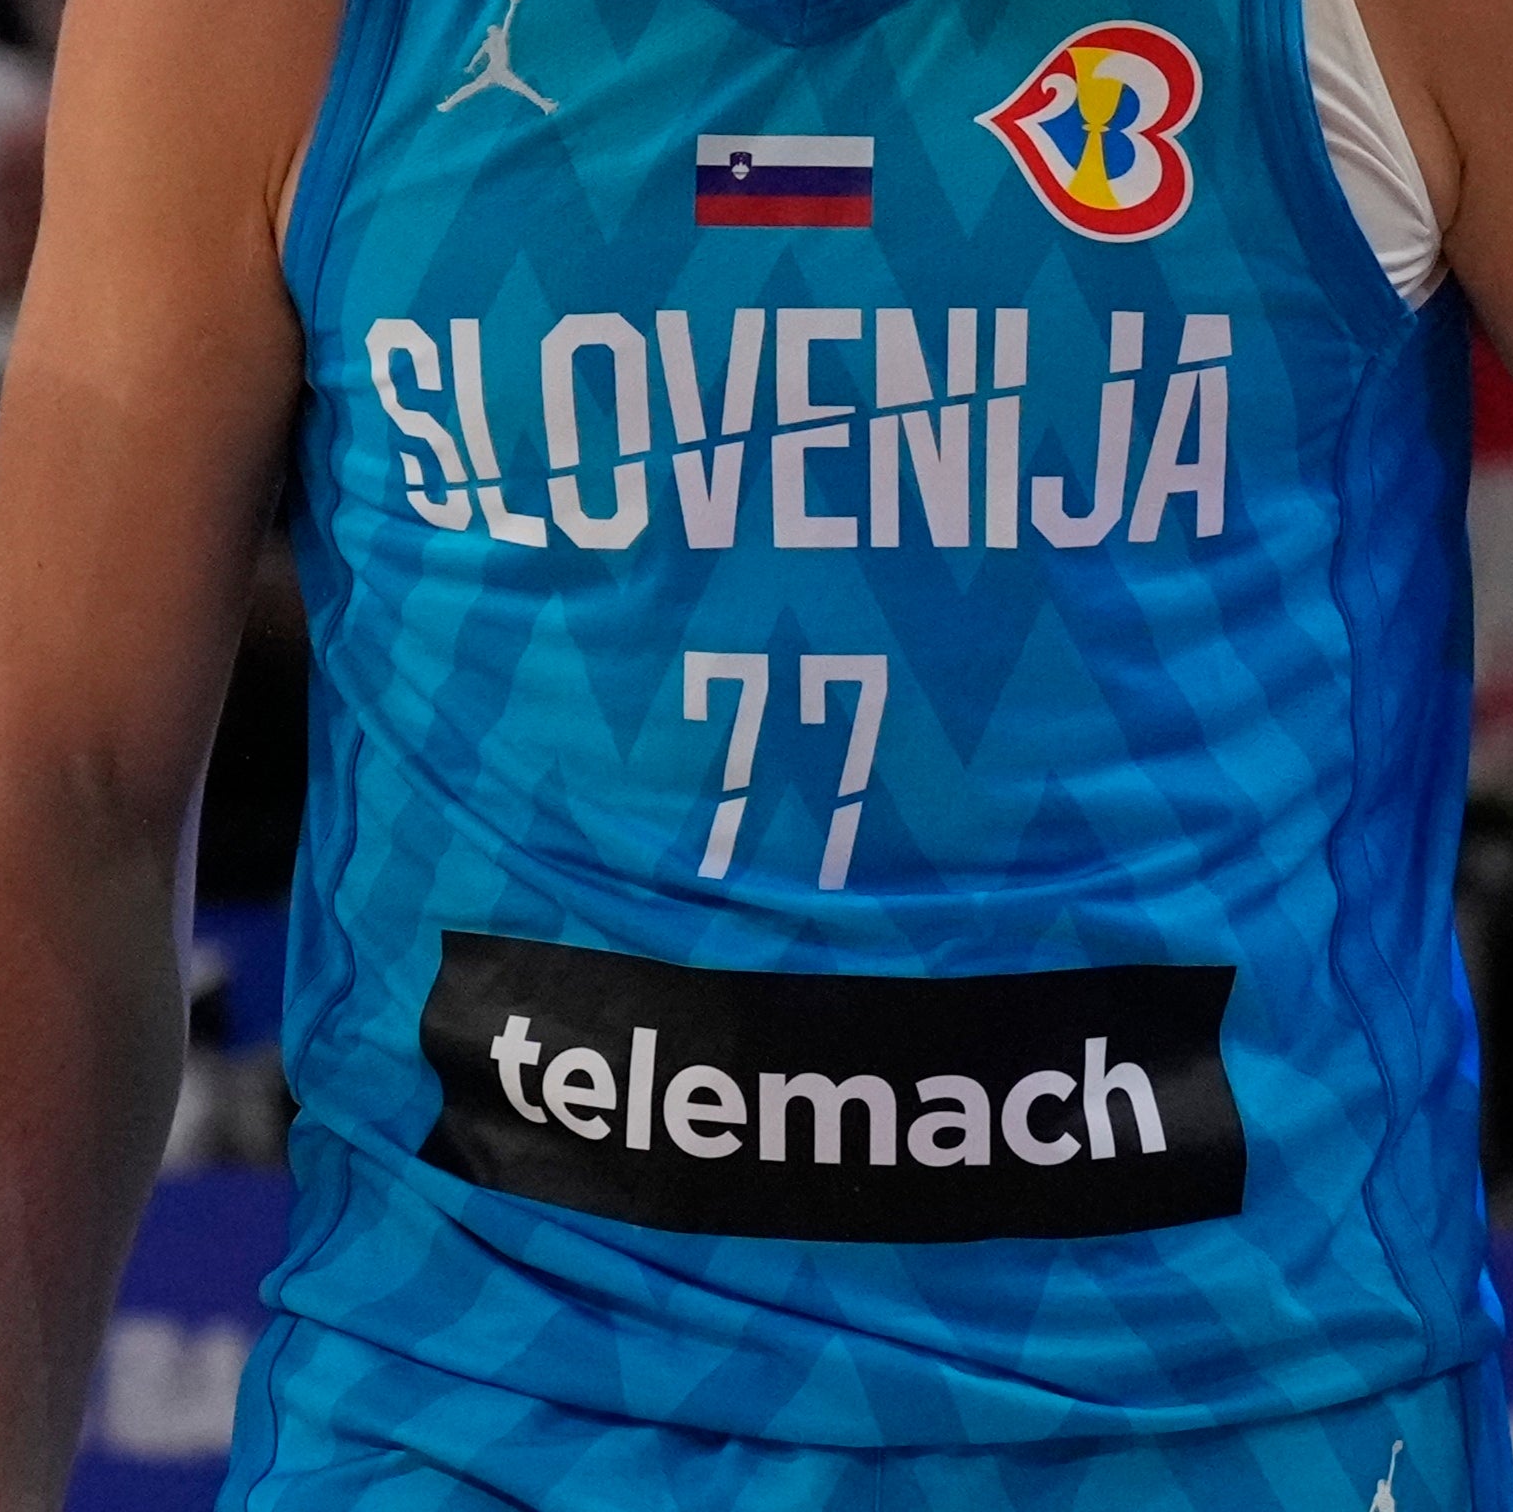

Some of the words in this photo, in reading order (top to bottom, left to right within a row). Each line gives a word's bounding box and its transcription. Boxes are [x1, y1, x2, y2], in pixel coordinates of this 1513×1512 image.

[364, 307, 1232, 549] SLOVENIJA
[683, 651, 887, 890] 77
[490, 1015, 1167, 1167] telemach
